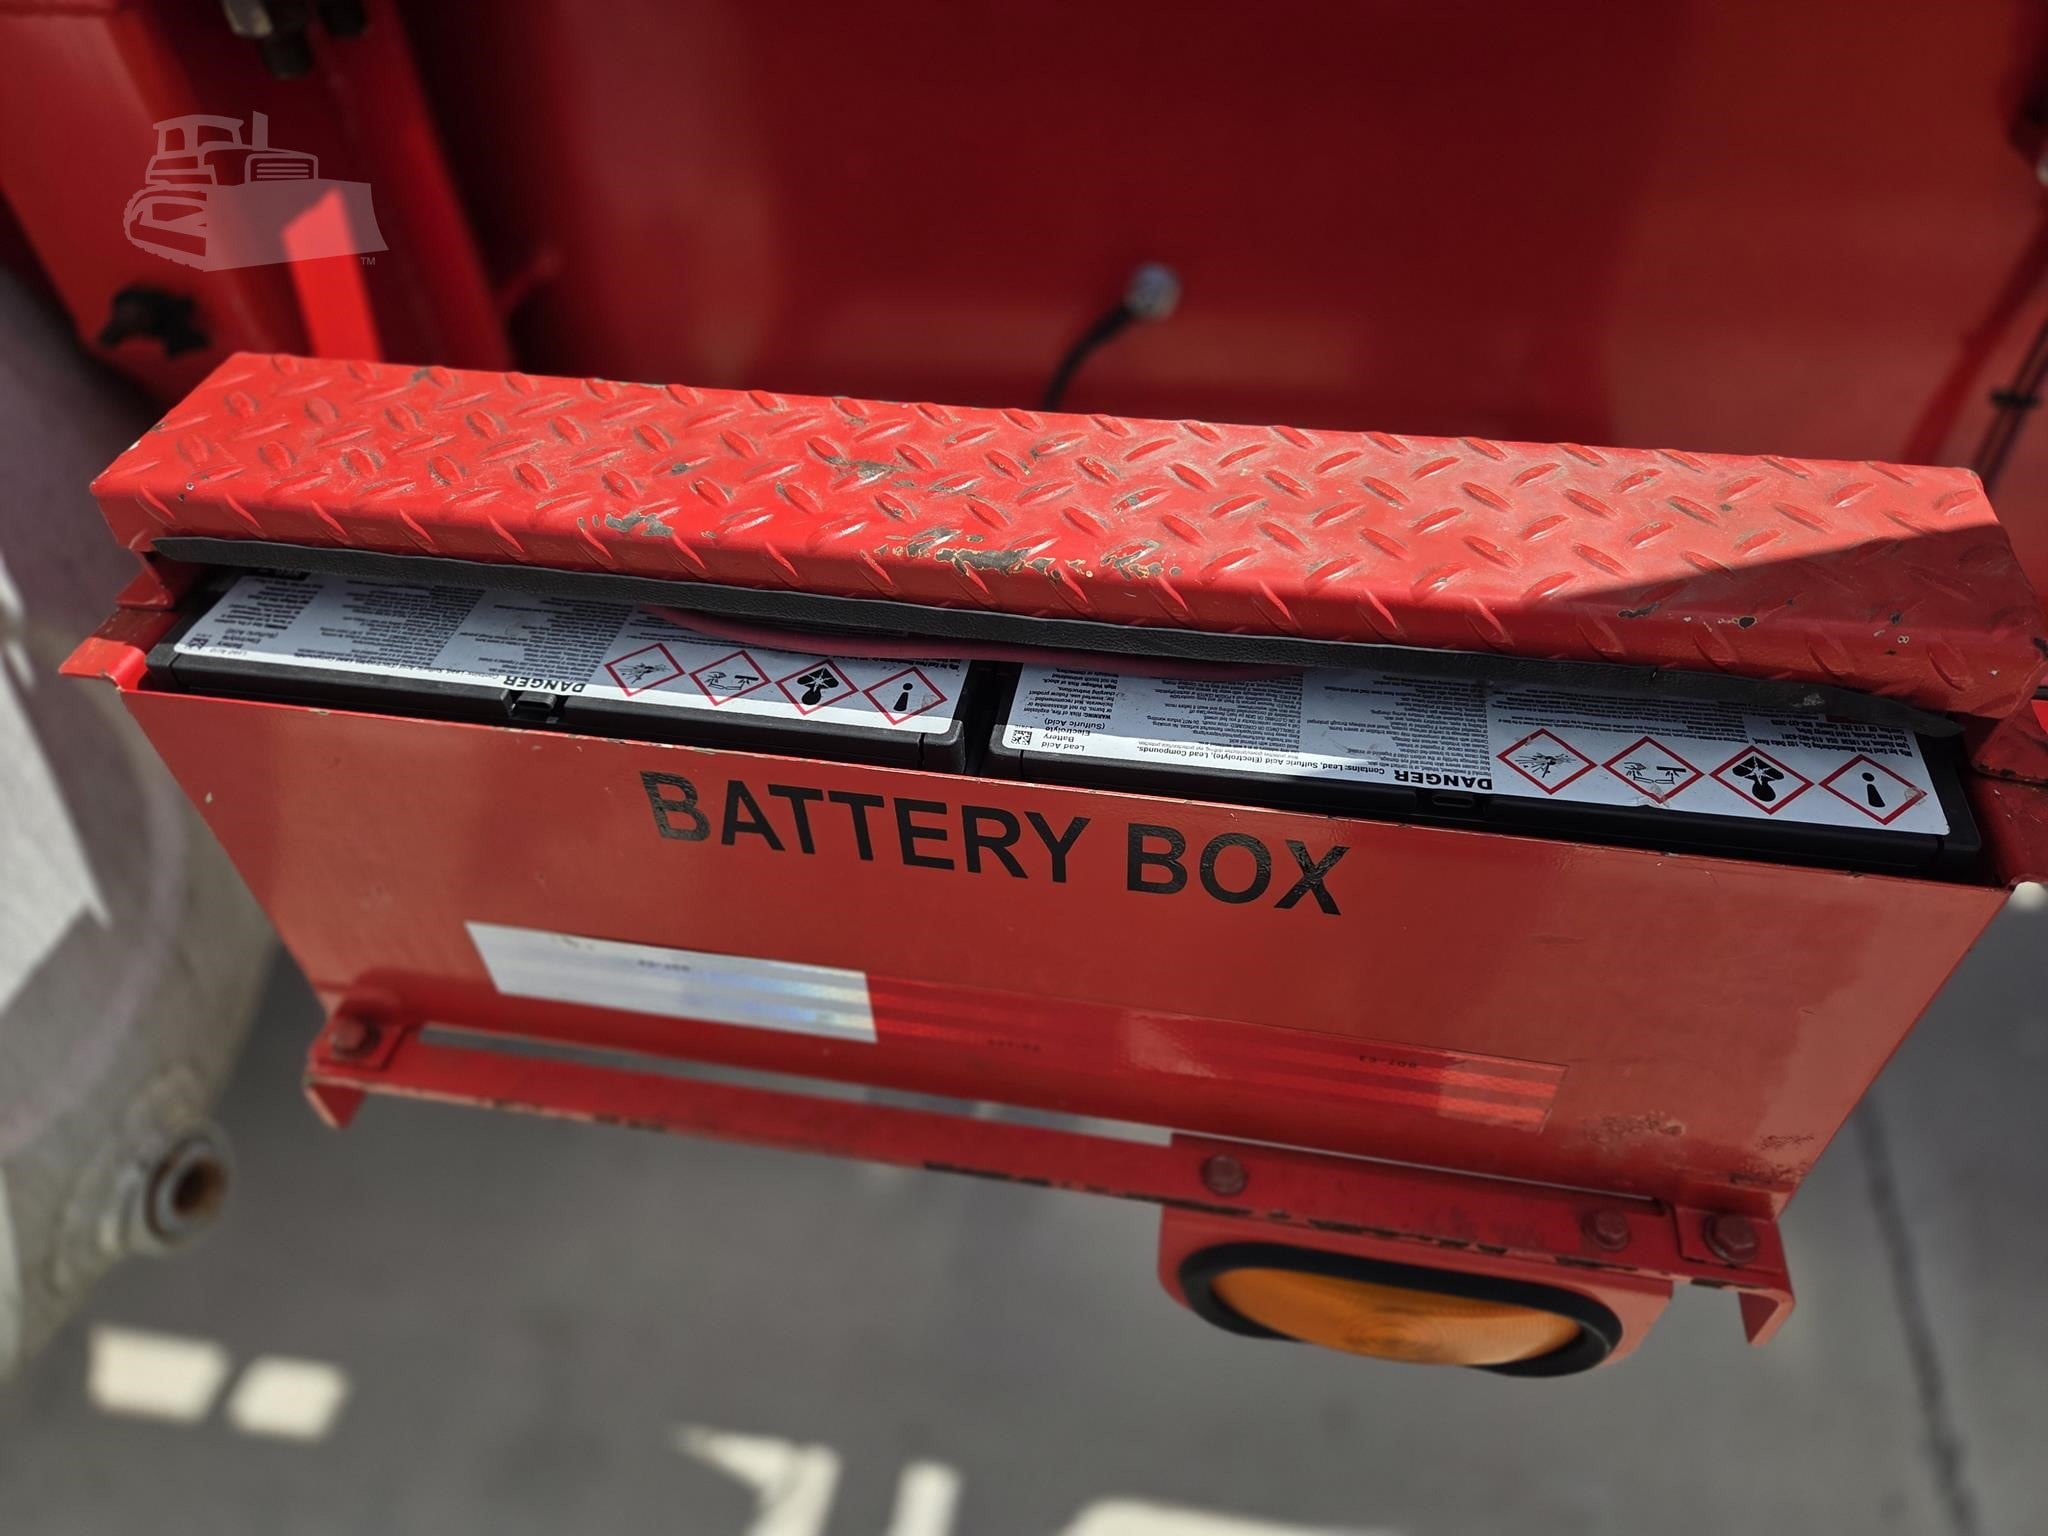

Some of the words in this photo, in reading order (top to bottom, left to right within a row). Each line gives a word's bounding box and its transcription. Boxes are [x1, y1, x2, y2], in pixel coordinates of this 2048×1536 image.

[503, 676, 586, 693] DANGER
[1044, 718, 1068, 728] Acid)
[1069, 719, 1106, 730] (Sulfuric
[1045, 726, 1091, 736] Electrolyte
[1043, 733, 1074, 743] Battery
[1042, 742, 1062, 750] Acid
[1064, 744, 1085, 752] Lead
[1137, 746, 1186, 757] Compounds.
[1188, 751, 1209, 759] Lead
[1210, 752, 1263, 764] (Electrolyte),
[1265, 758, 1284, 766] Acid
[1286, 759, 1318, 769] Sulfuric
[1320, 762, 1343, 772] Lead,
[1344, 765, 1385, 775] Contains:
[1394, 769, 1492, 789] DANGER
[638, 770, 1091, 884] BATTERY
[1126, 822, 1350, 916] BOX
